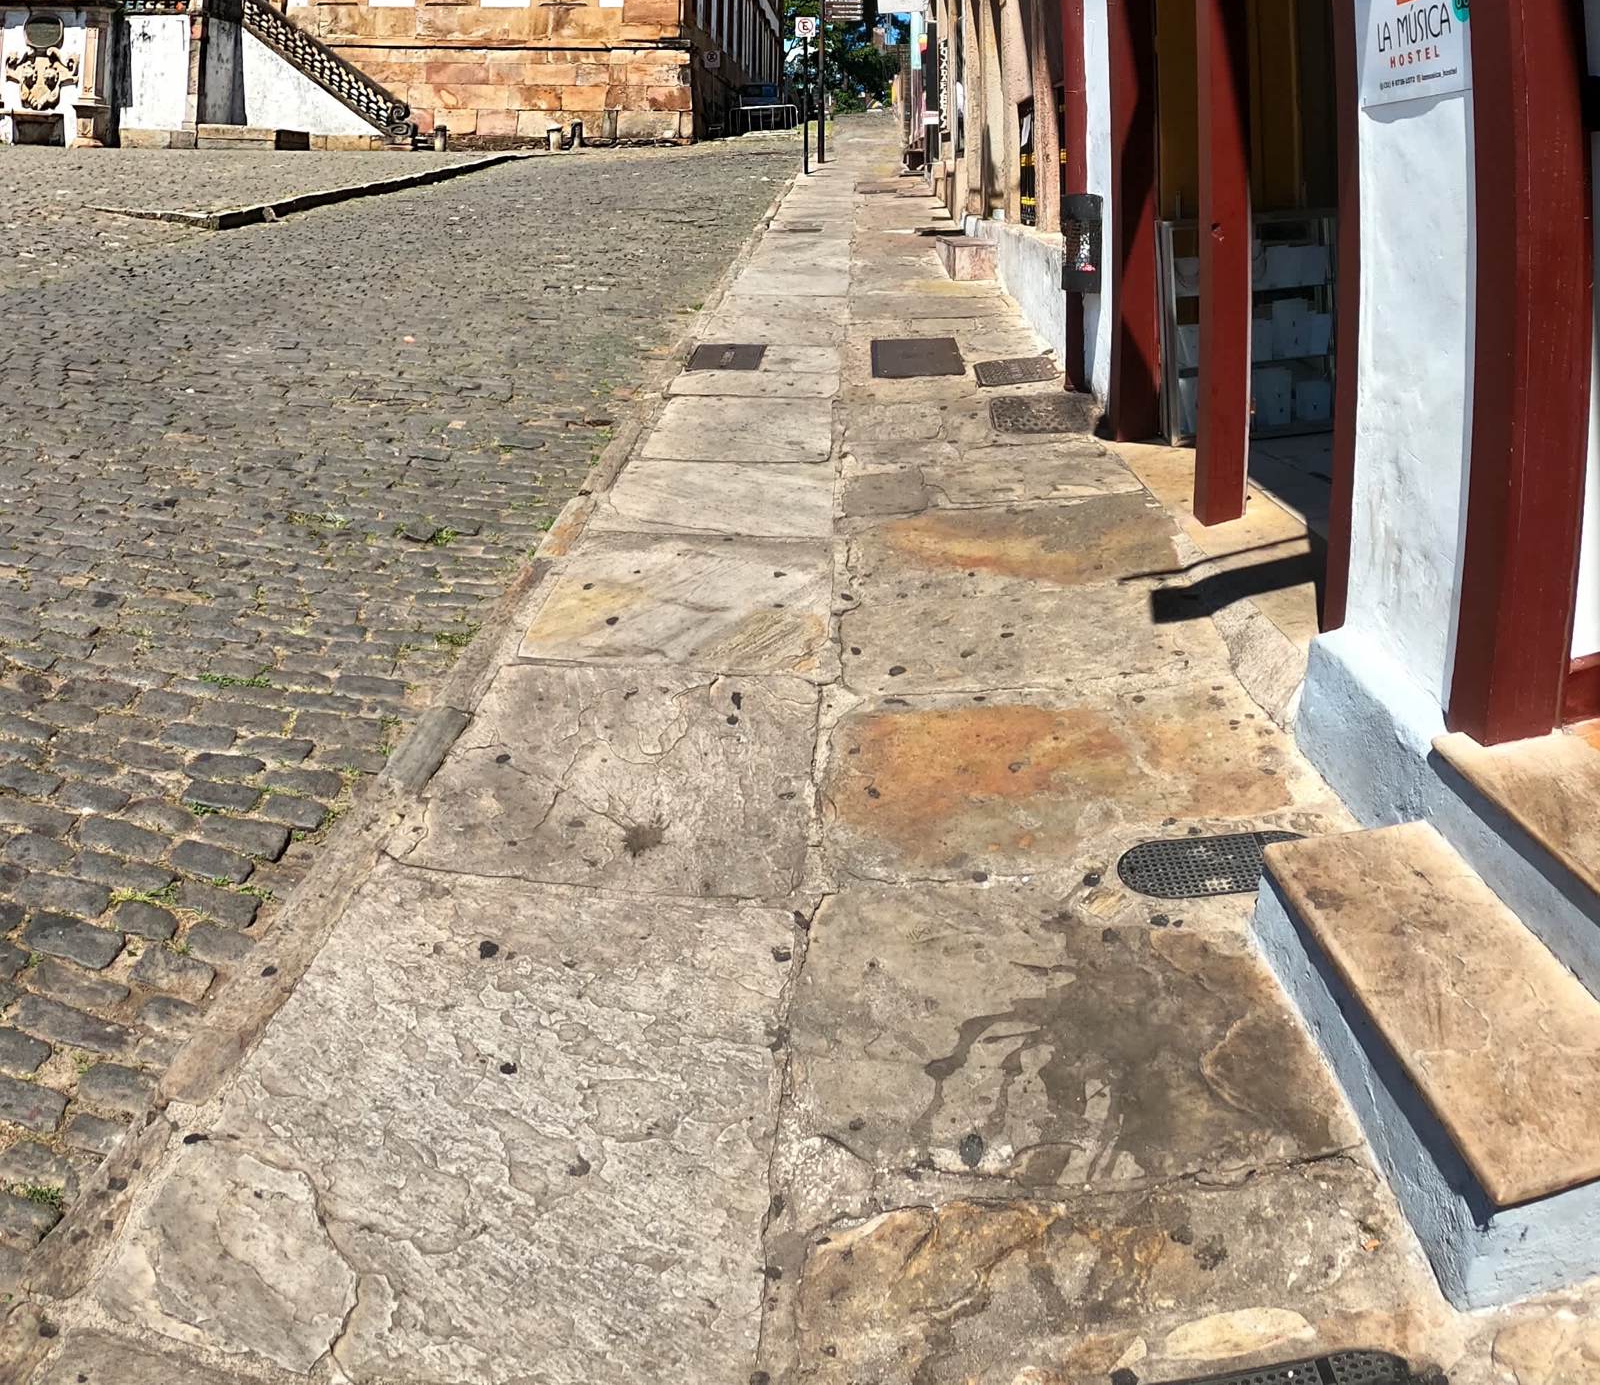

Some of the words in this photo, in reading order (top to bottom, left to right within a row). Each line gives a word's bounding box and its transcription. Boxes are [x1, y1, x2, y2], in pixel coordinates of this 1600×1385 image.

[1376, 21, 1392, 53] LA
[1397, 3, 1452, 47] MÚSICA
[1390, 44, 1441, 68] HOSTEL
